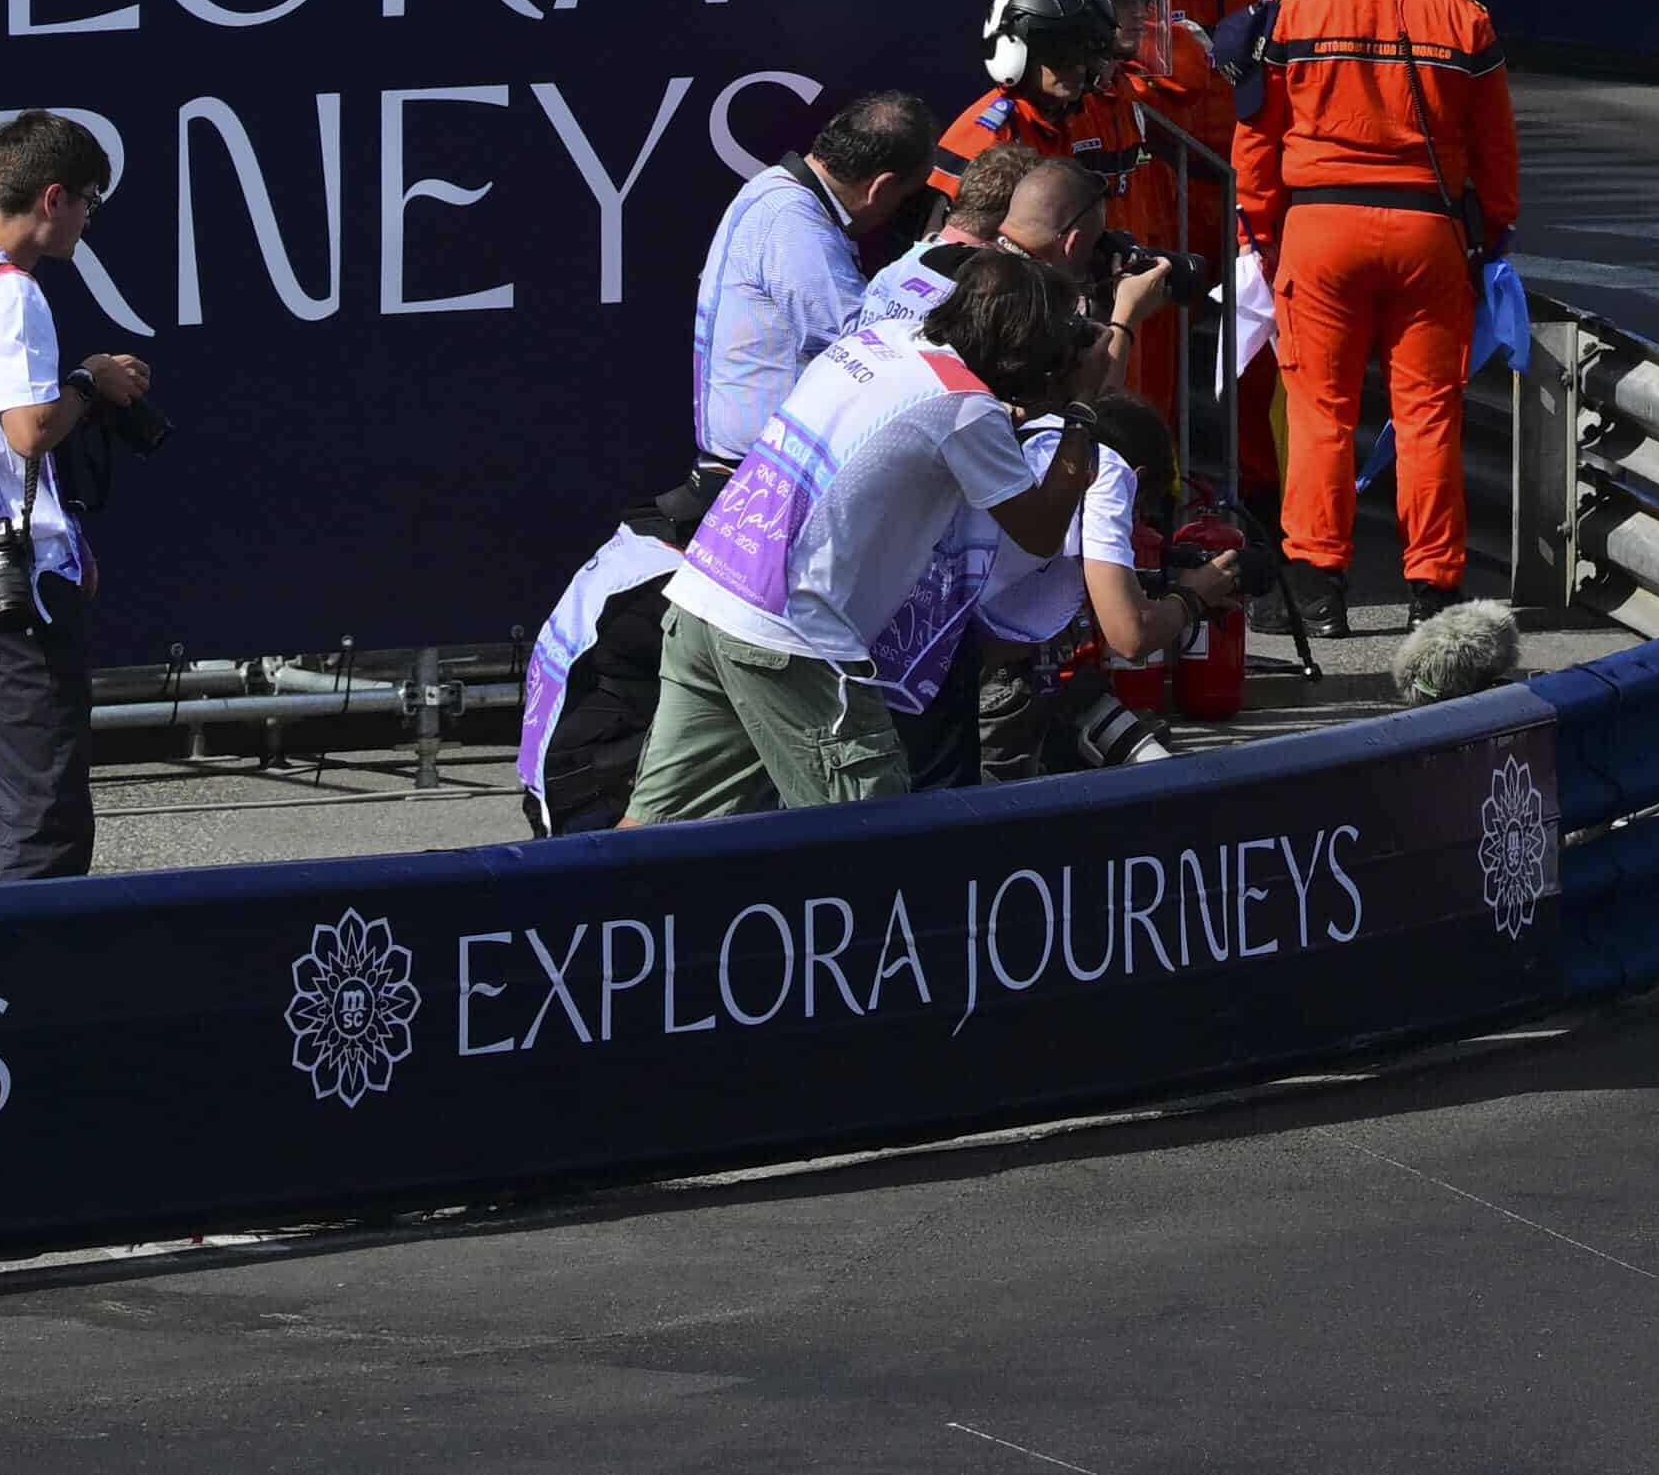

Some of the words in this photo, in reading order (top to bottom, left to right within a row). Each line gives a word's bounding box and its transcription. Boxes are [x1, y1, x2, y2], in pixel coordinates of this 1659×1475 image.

[1410, 45, 1450, 60] MONACO
[459, 889, 931, 1056] EXPLORA
[952, 825, 1363, 1037] JOURNEYS
